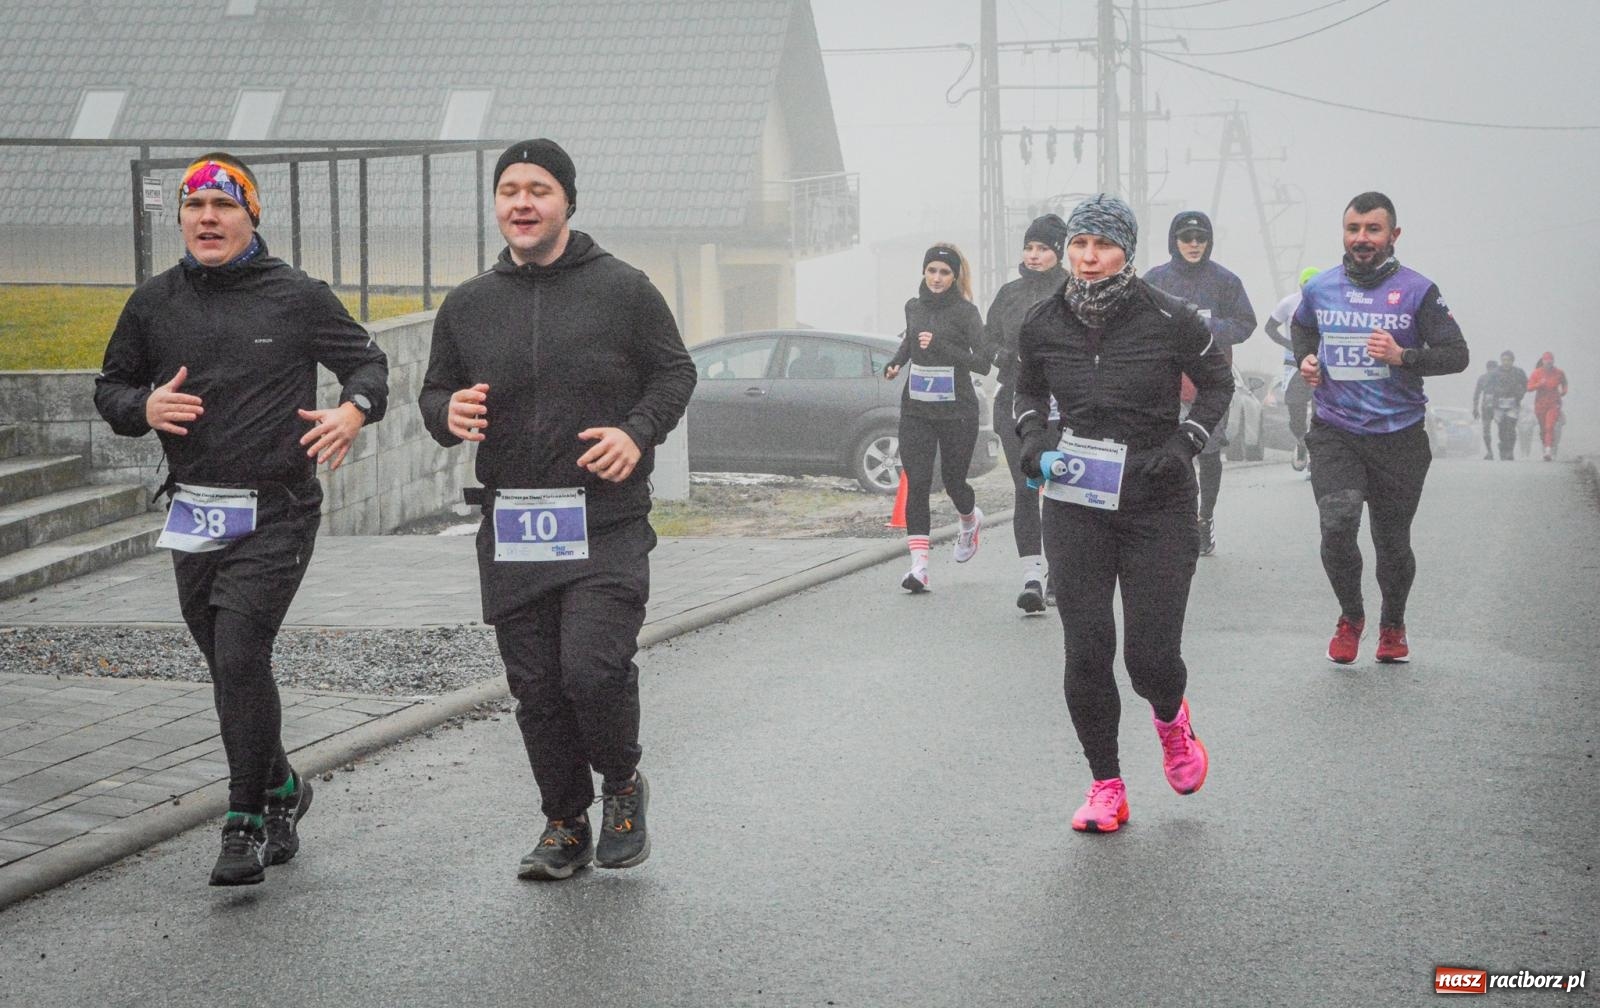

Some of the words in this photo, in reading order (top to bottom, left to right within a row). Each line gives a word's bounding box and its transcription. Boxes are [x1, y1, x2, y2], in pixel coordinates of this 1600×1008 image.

[1315, 309, 1412, 330] RUNNERS
[923, 377, 935, 392] 7
[191, 507, 226, 538] 98
[518, 511, 558, 541] 10
